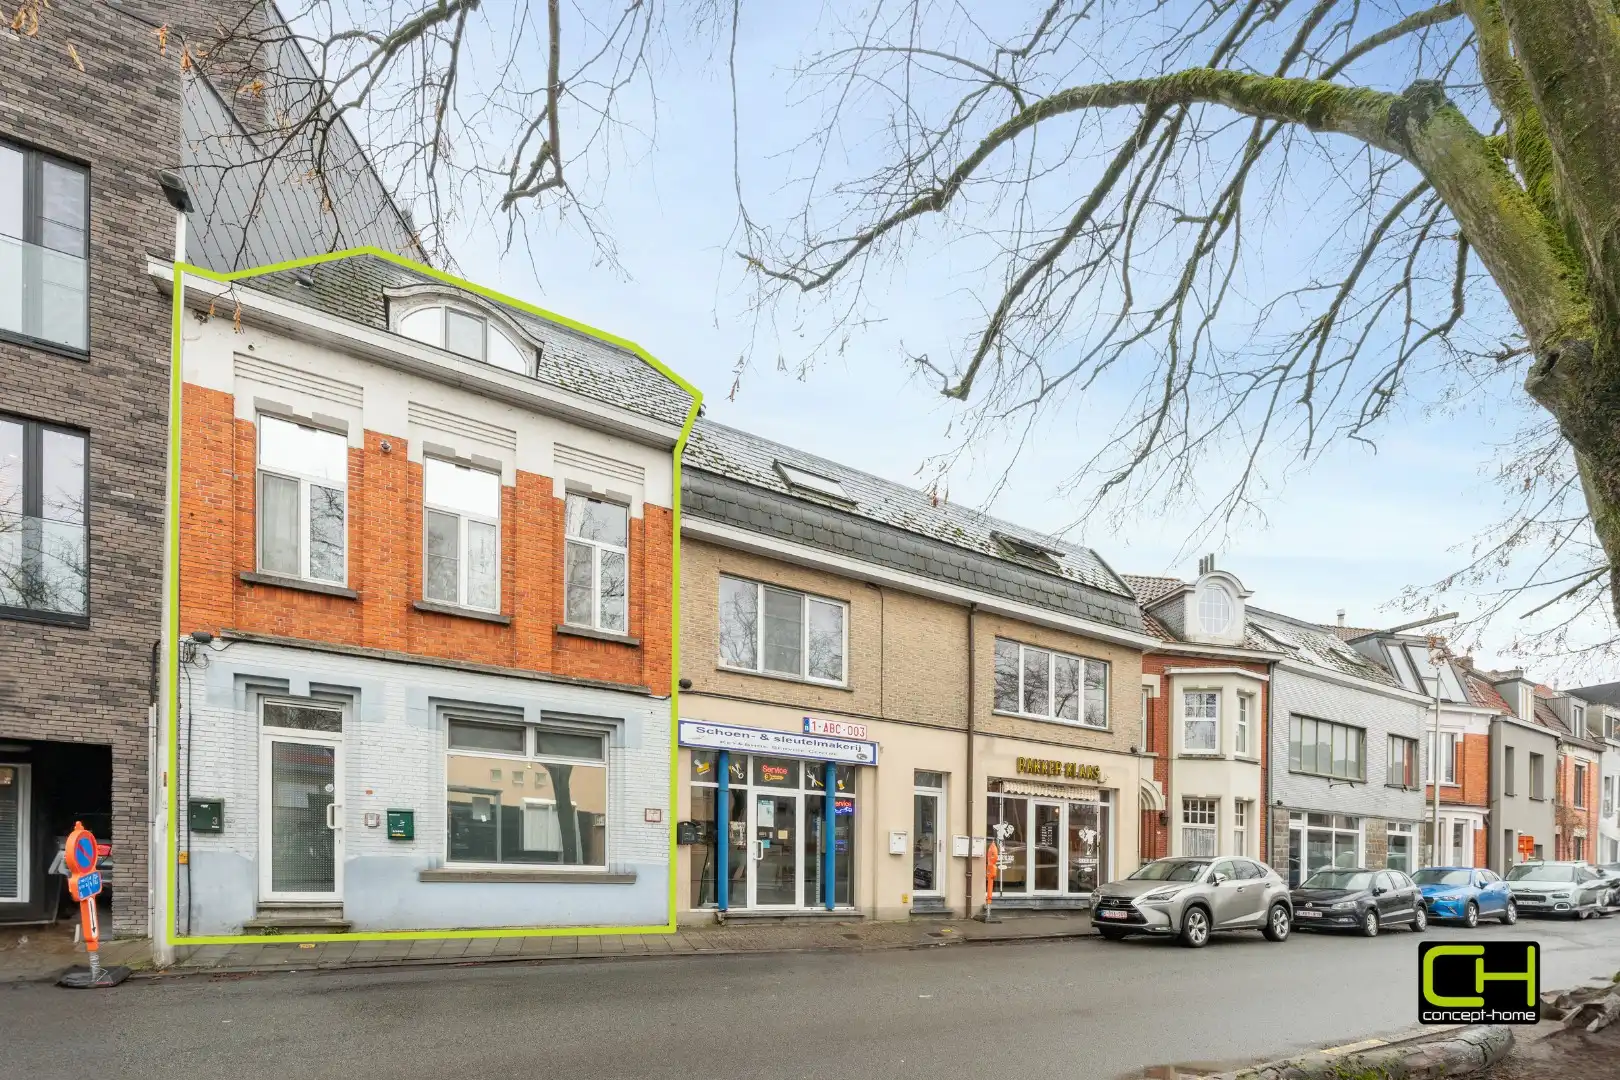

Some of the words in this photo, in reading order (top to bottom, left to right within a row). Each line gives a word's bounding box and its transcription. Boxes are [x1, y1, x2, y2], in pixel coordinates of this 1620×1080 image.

[696, 726, 756, 740] Schoen-
[760, 733, 769, 741] &
[774, 735, 862, 753] sleutelmakerij
[762, 765, 788, 774] Service
[1016, 756, 1062, 776] BAKKER
[1064, 762, 1100, 780] KLAAS
[835, 800, 851, 808] ervice
